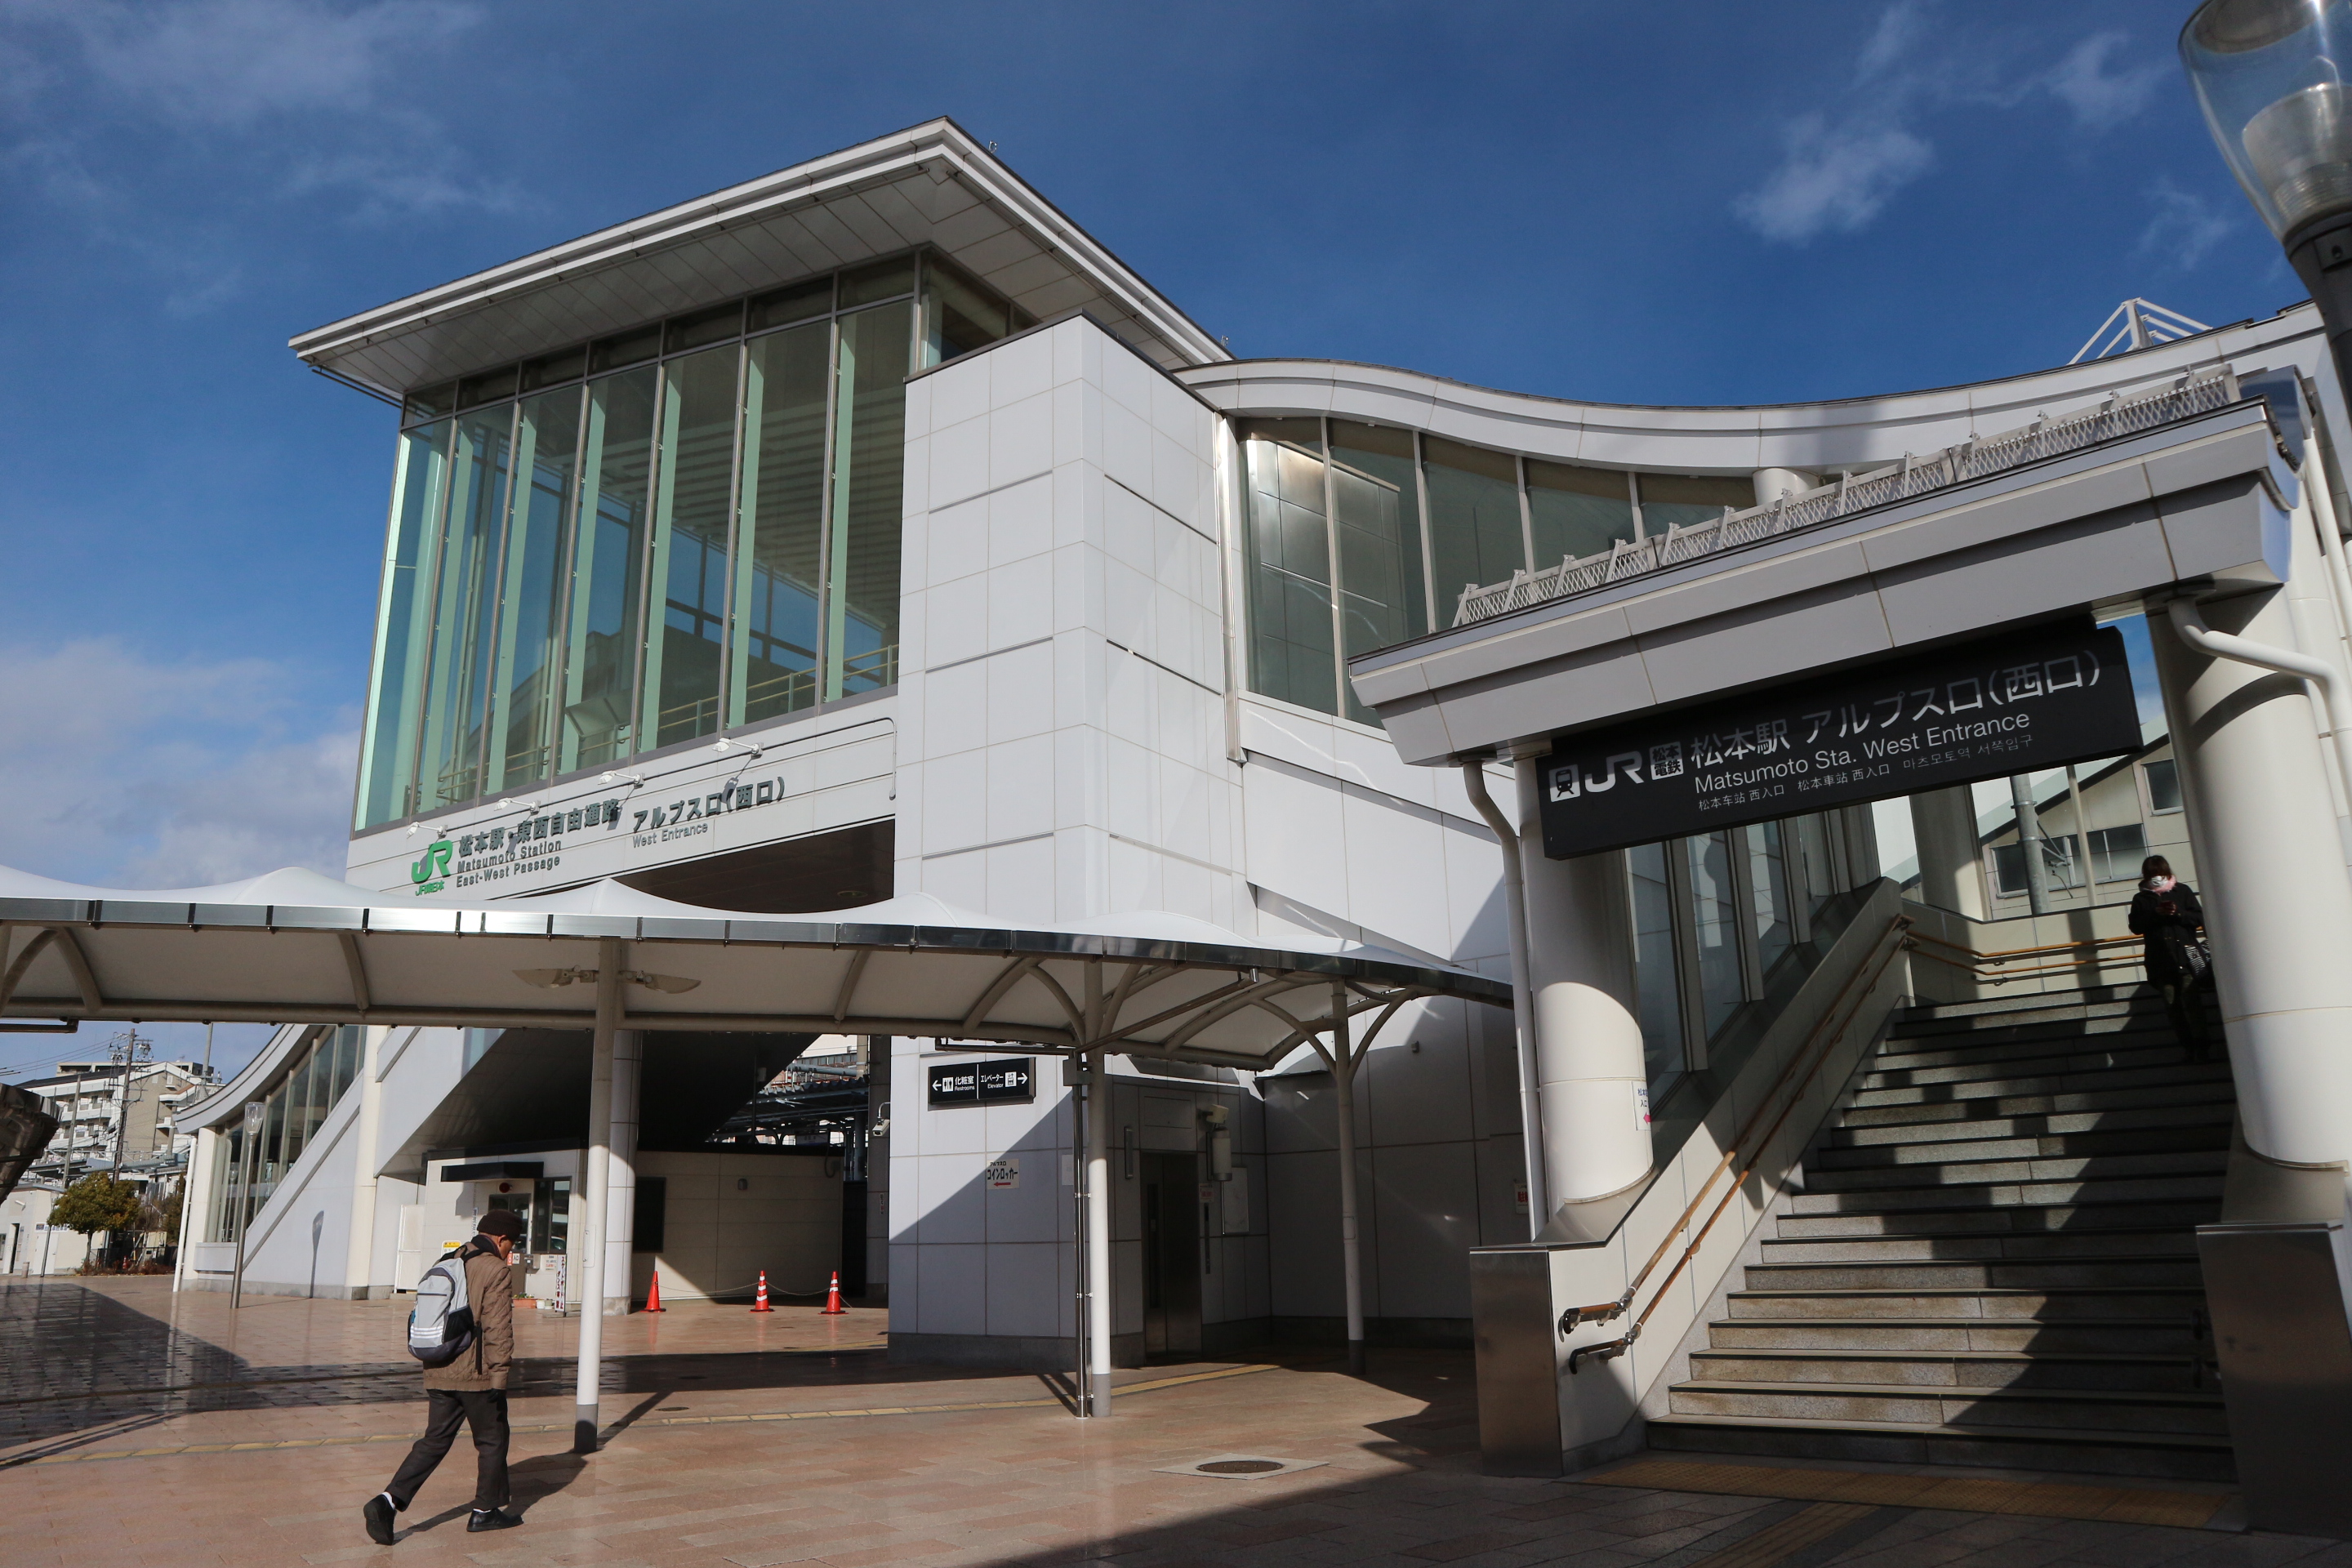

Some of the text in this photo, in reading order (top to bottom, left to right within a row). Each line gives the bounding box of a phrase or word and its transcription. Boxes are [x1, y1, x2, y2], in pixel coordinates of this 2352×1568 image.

[1690, 650, 2100, 769] 松本駅 アルプス口(西口)
[1652, 745, 1680, 763] 松本
[1654, 760, 1682, 777] 電鉄
[1695, 713, 2030, 794] Matsumoto Sta. West Entrance
[1903, 734, 2034, 771] 마츠모토역 서쪽입구
[1584, 750, 1645, 793] JR
[1698, 764, 1890, 812] 松本车站 西入口 松本車站 西入口
[633, 775, 786, 832] アルプス口(西口)
[458, 799, 619, 858] 松本駅・東西自由通路
[633, 822, 708, 849] West Entrance
[411, 840, 453, 884] JR
[456, 856, 560, 888] East-West Passage
[457, 840, 562, 874] Matsumoto Station
[415, 880, 445, 896] JR東日本
[955, 1076, 974, 1085] 化粧室
[980, 1073, 1004, 1083] エレベーター
[987, 1167, 1018, 1180] コインロッカー
